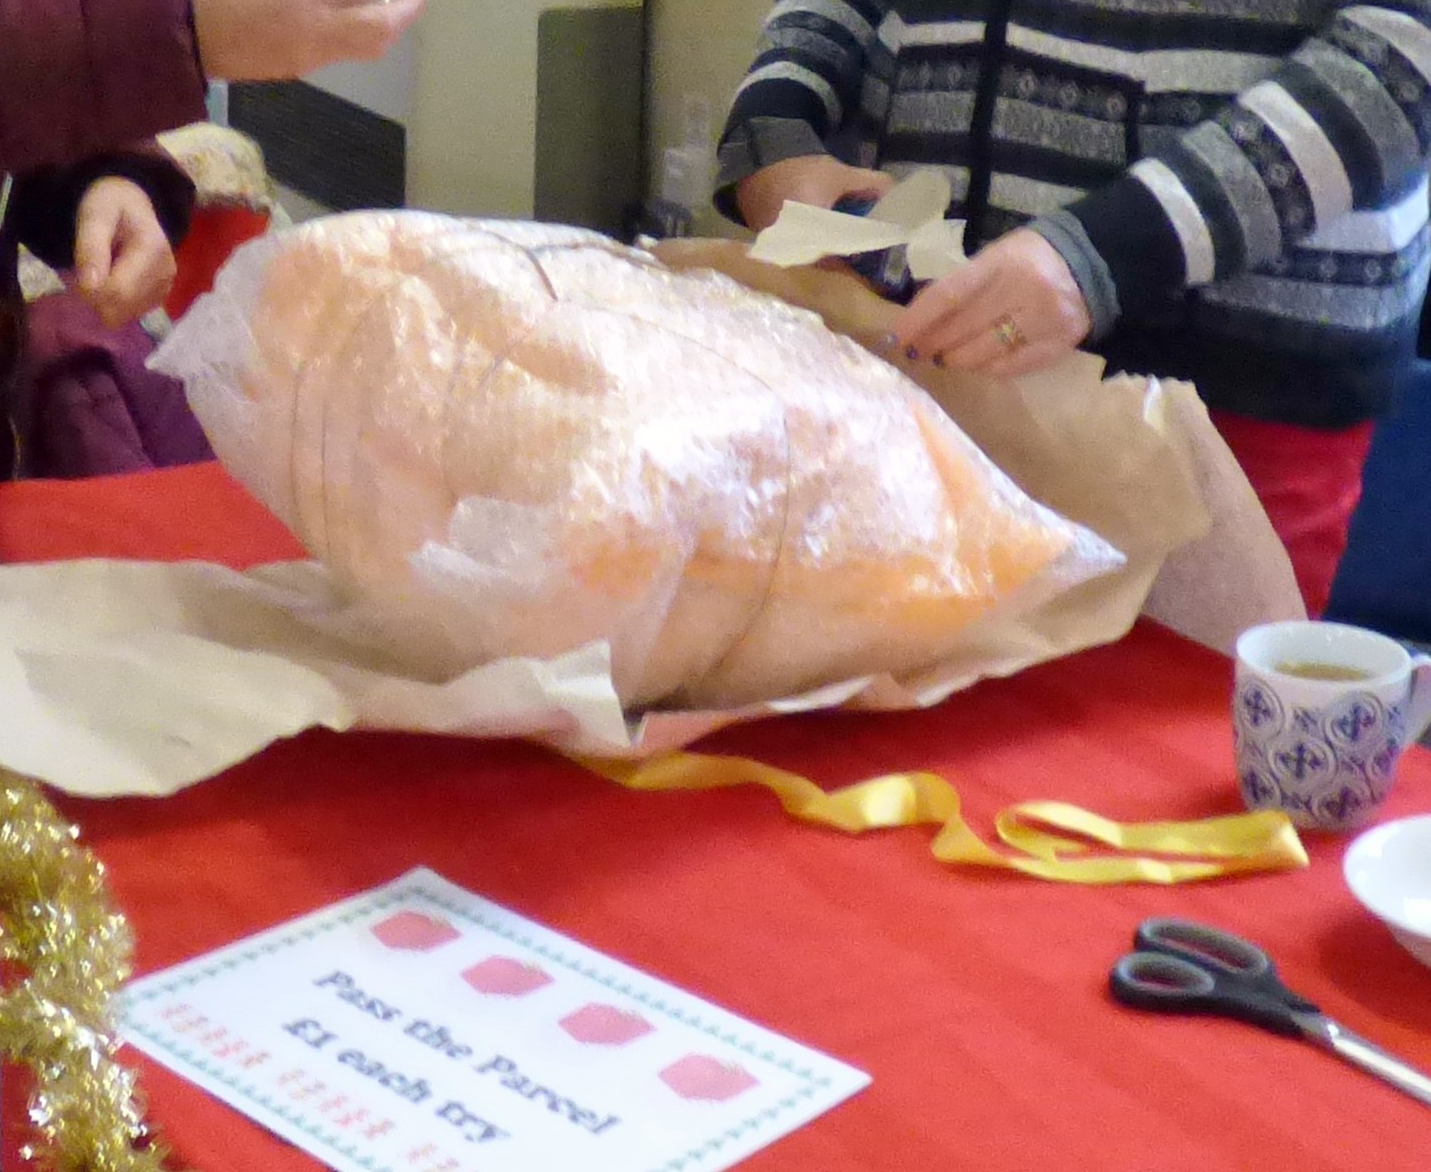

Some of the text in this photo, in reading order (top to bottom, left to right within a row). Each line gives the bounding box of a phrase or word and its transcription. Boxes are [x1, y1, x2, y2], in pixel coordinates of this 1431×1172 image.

[281, 1017, 511, 1143] £1 each try
[312, 970, 621, 1135] Pass the Parcel
